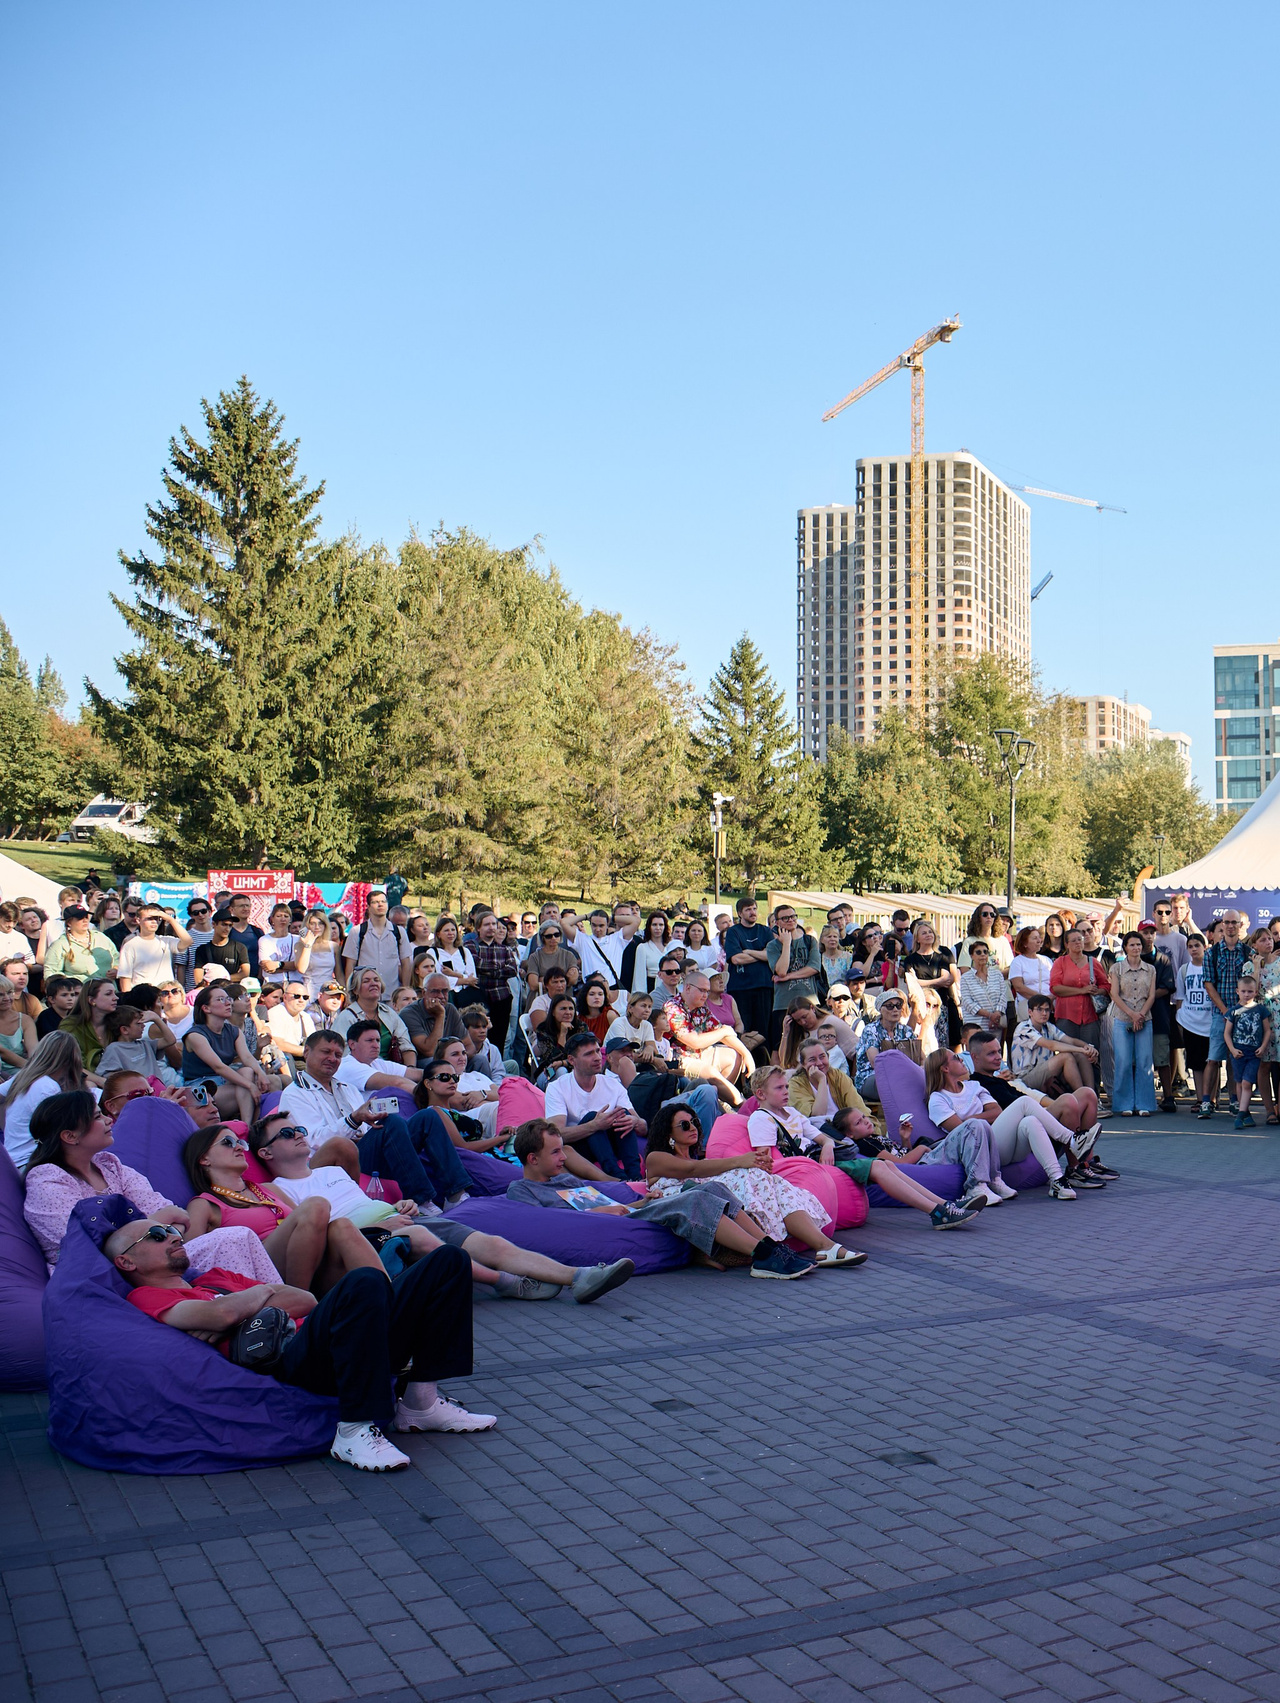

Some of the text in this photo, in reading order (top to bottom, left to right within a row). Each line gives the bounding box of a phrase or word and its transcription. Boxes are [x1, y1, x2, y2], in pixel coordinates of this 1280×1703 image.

[233, 876, 268, 890] ЦНМТ
[1258, 909, 1270, 918] 30
[1191, 992, 1202, 1004] 09
